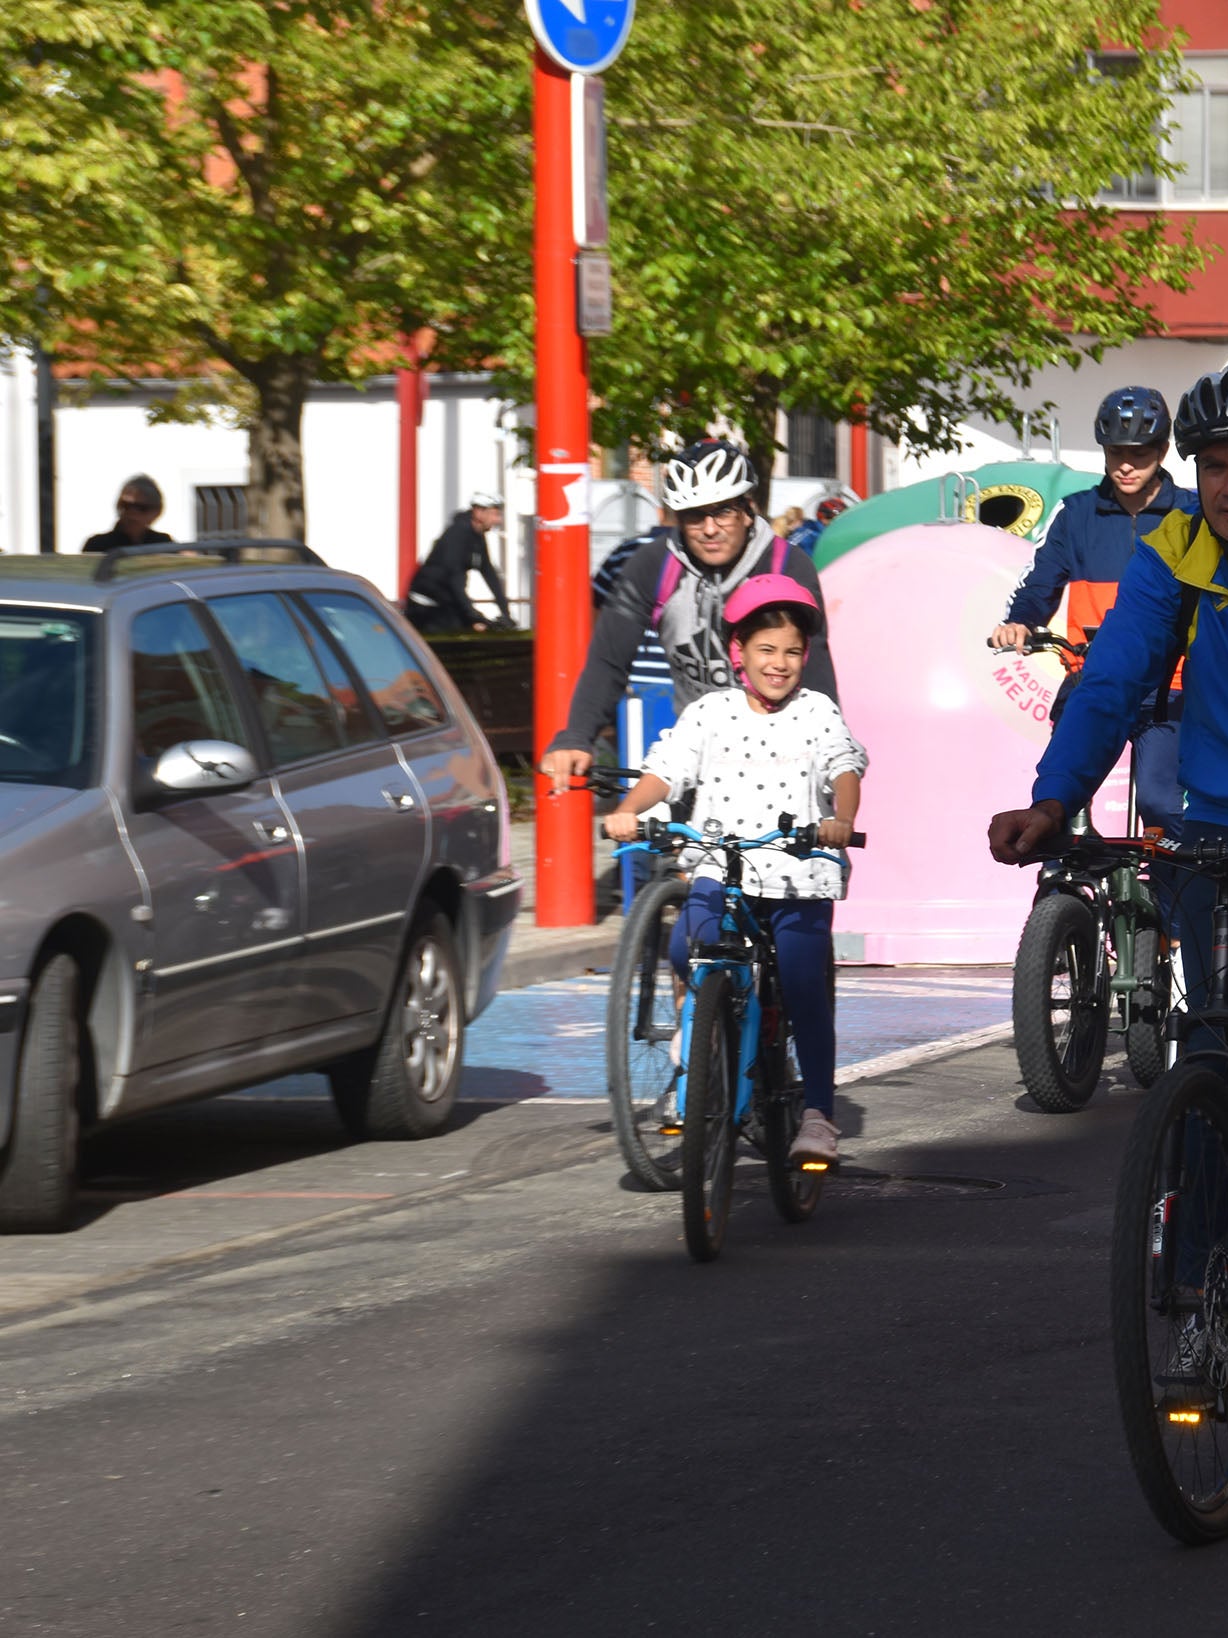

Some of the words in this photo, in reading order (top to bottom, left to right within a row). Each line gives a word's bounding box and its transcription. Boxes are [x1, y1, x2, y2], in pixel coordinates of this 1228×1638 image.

[673, 653, 743, 689] adid
[1012, 660, 1053, 704] NADIE
[992, 666, 1054, 727] MEJO
